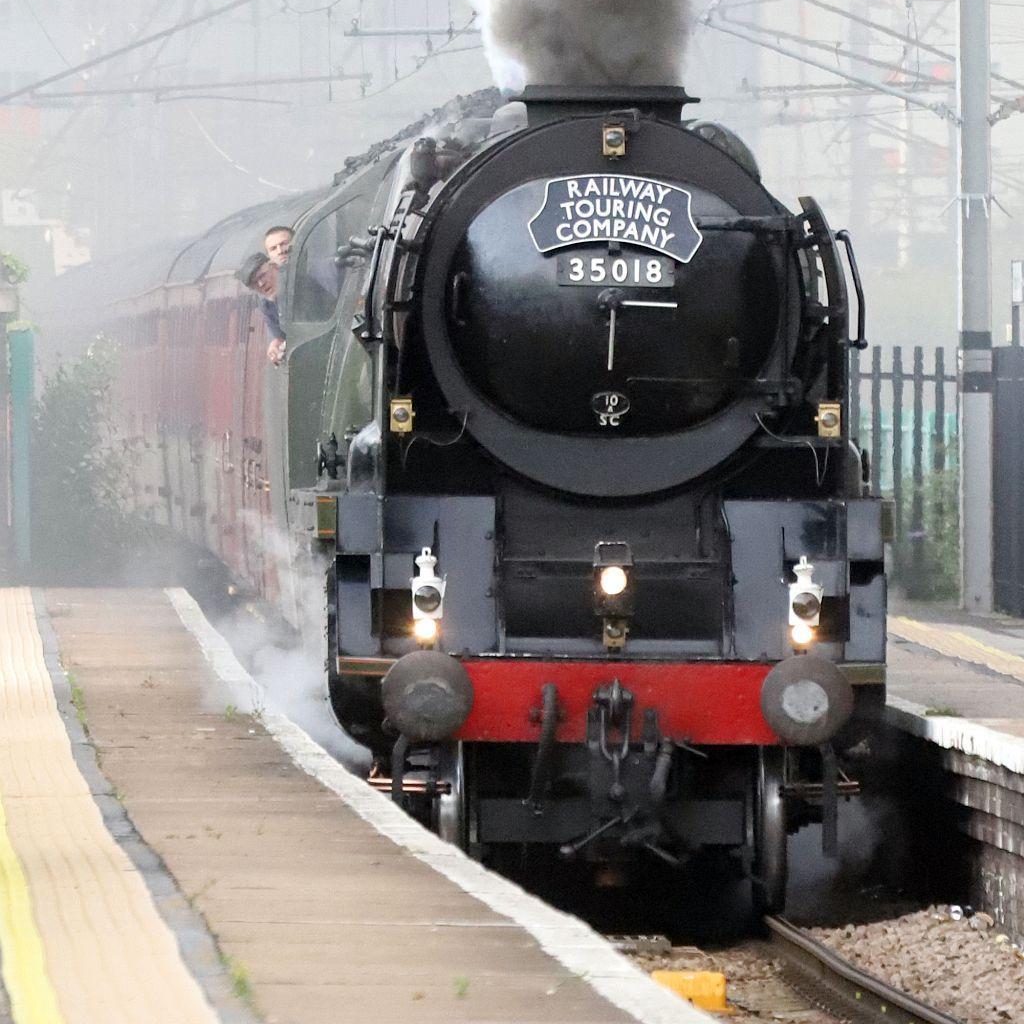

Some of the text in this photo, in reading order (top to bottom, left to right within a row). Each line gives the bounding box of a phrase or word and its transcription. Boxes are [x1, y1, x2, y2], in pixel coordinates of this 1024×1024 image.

[568, 178, 671, 204] RAILWAY
[561, 200, 671, 226] TOURING
[556, 220, 675, 248] COMPANY
[569, 258, 662, 282] 35018
[599, 415, 620, 426] SC
